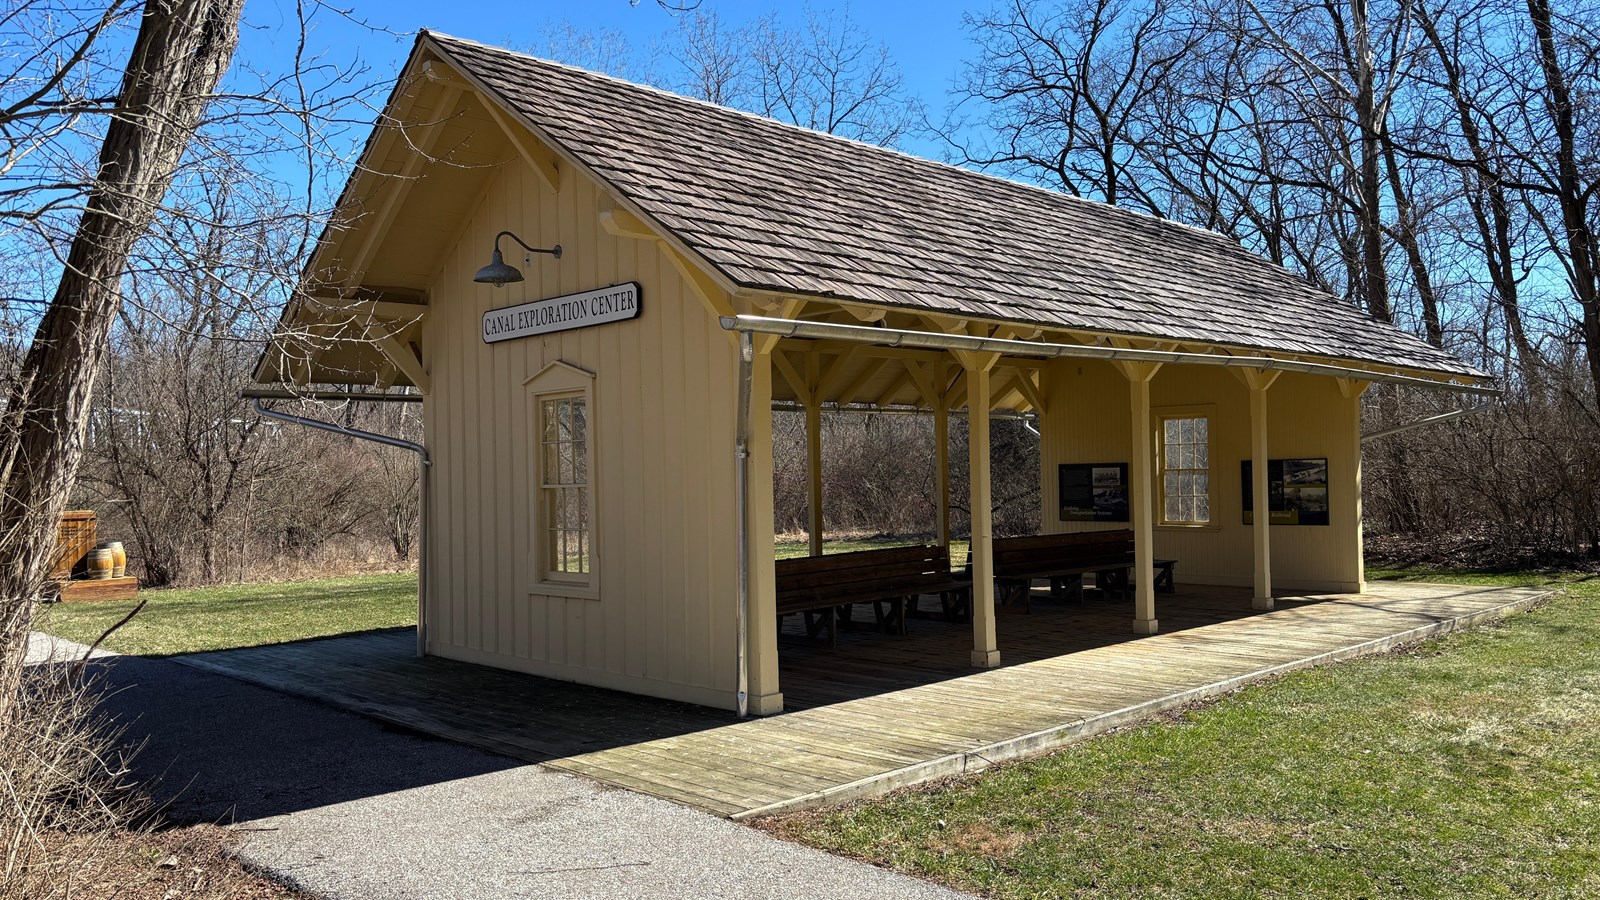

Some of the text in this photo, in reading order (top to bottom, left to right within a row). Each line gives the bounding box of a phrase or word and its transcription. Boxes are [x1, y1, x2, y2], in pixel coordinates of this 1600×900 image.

[484, 290, 635, 336] CANAL EXPLORATION CENTER
